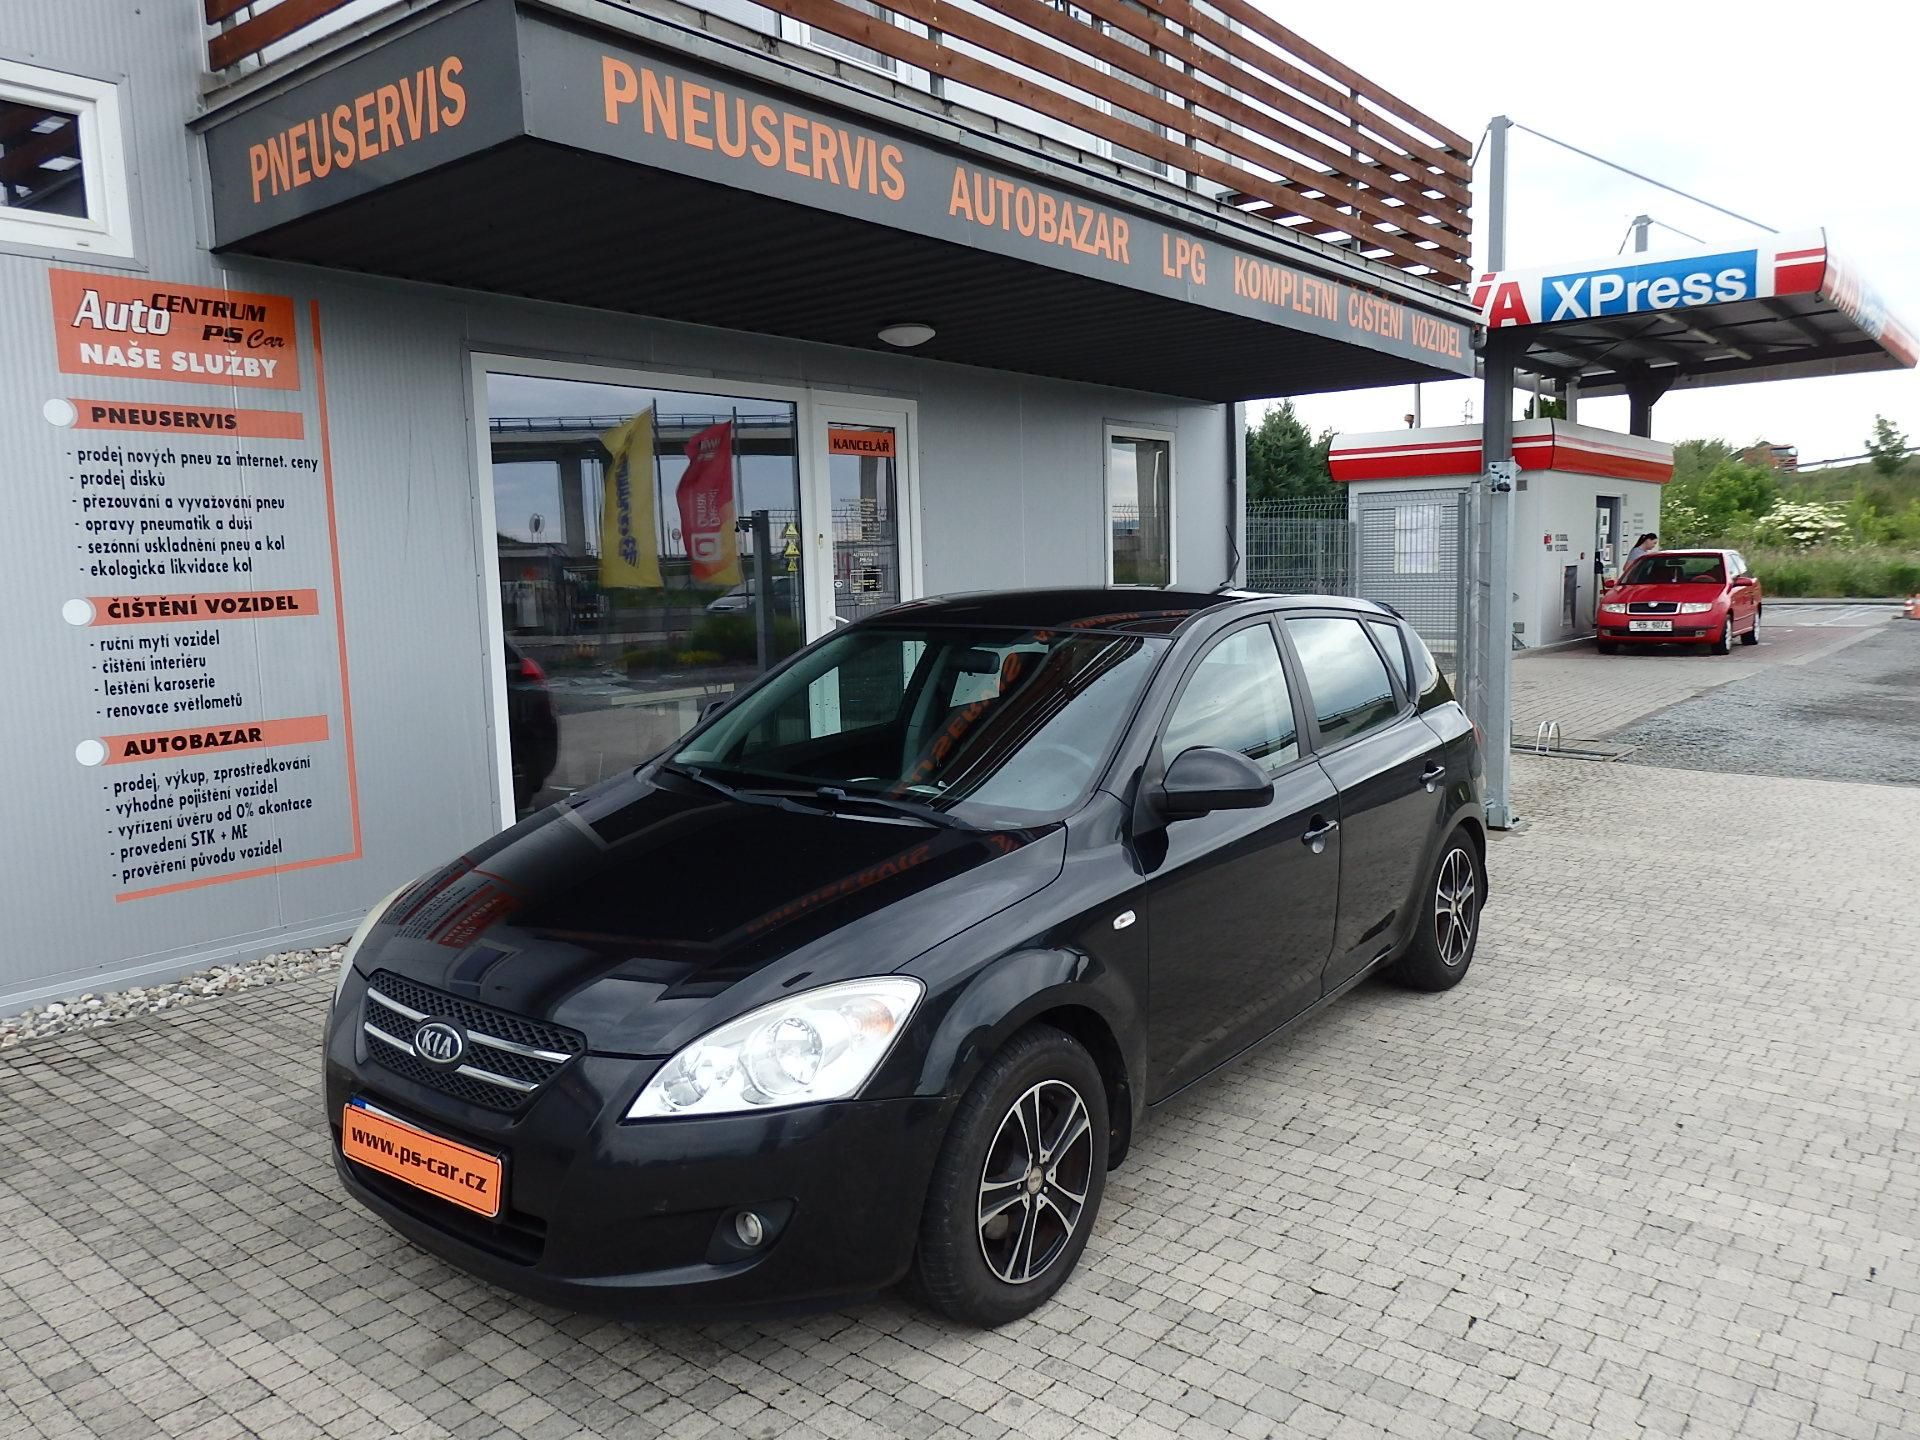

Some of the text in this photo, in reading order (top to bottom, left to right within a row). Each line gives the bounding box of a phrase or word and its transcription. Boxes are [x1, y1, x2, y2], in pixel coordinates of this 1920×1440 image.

[250, 56, 467, 203] PNEUSERVIS
[601, 56, 1463, 359] PNEUSERVIS AUTOBAZAR LPG KOMPLETNÍ ČIŠTĚNÍ VOZIDEL
[1551, 267, 1747, 321] XPress
[71, 288, 266, 336] Auto CENTRUM
[202, 325, 285, 349] PS Car
[79, 340, 277, 379] NAŠE SLUŽBY
[91, 406, 237, 429] PNEUSERVIS
[833, 438, 889, 452] KANCELÁŘ
[78, 446, 318, 472] prodej nových pneu za internet. ceny
[81, 469, 125, 490] prodej
[83, 494, 285, 512] přezouvání a vyvažování pneu
[86, 520, 134, 535] opravy
[140, 514, 210, 534] pneumatik
[216, 520, 223, 529] a
[88, 535, 285, 555] sezónní uskladnění pneu a kol
[91, 557, 252, 579] ekologická likvidace kol
[107, 595, 299, 618] ČIŠTĚNÍ VOZIDEL
[100, 629, 220, 652] ruční mytí vozidel
[102, 653, 206, 673] čištění interiéru
[104, 673, 215, 696] leštění karoserie
[107, 693, 242, 718] renovace světlometů
[123, 728, 262, 757] AUTOBAZAR
[114, 755, 311, 797] prodej, výkup, zprostředkování
[115, 778, 278, 818] výhodné pojištění vozidel
[118, 797, 313, 840] vyřízení úvěru od 0% akontace
[120, 835, 187, 862] provedení
[191, 828, 216, 847] STK
[231, 824, 248, 841] ME
[122, 838, 283, 884] prověření původu vozidel
[421, 1029, 452, 1059] KIA
[351, 1126, 487, 1193] www.ps-car.cz
